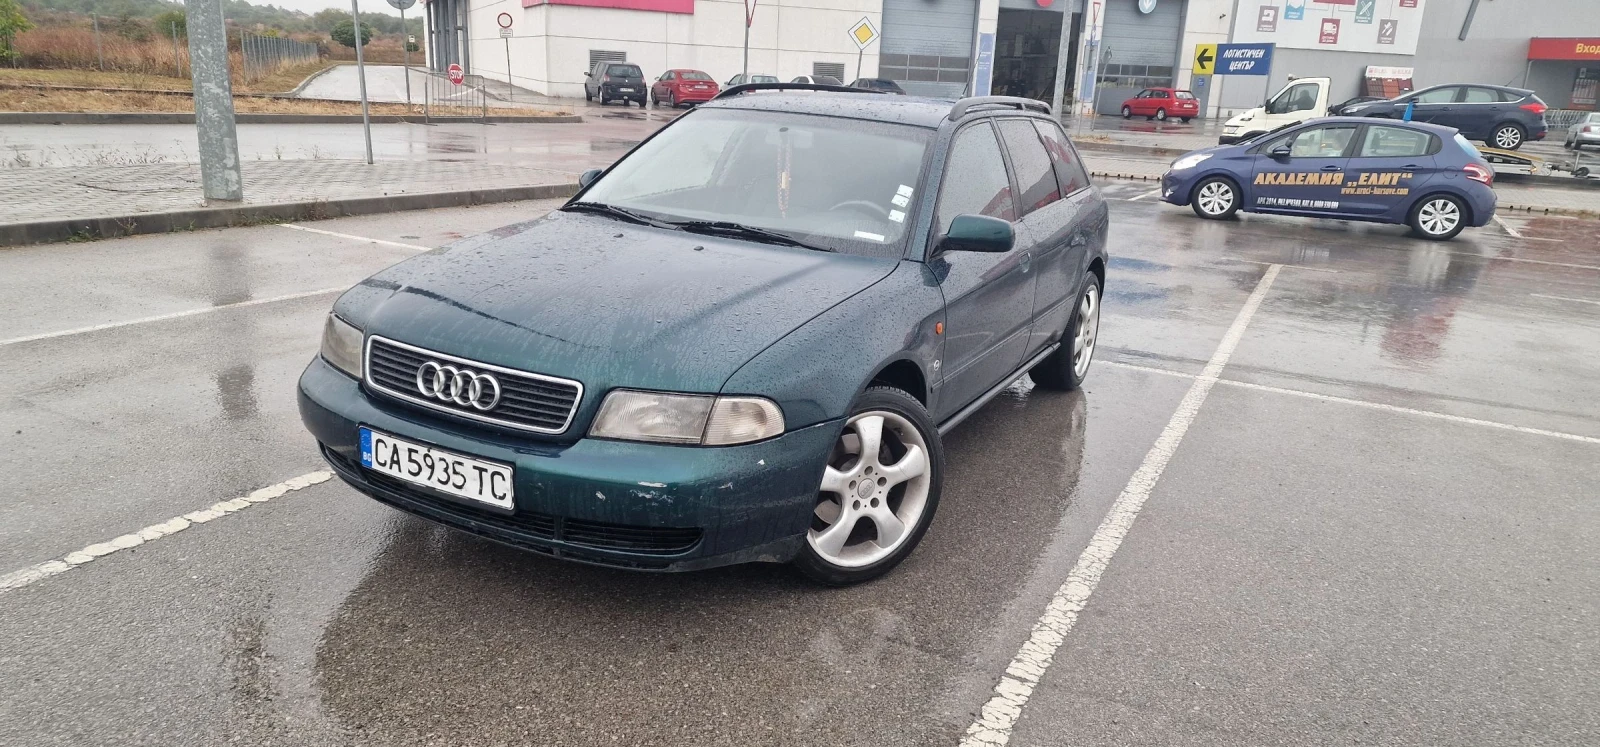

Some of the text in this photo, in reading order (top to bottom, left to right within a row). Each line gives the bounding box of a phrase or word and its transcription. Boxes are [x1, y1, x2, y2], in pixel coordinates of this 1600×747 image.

[1223, 49, 1265, 59] ЛОГИСТИЧЕН
[1229, 61, 1255, 72] ЦЕНТЪР
[450, 70, 464, 79] STOP
[1254, 173, 1344, 185] АКАДЕМИЯ
[363, 452, 372, 462] BG
[407, 449, 467, 490] 5935
